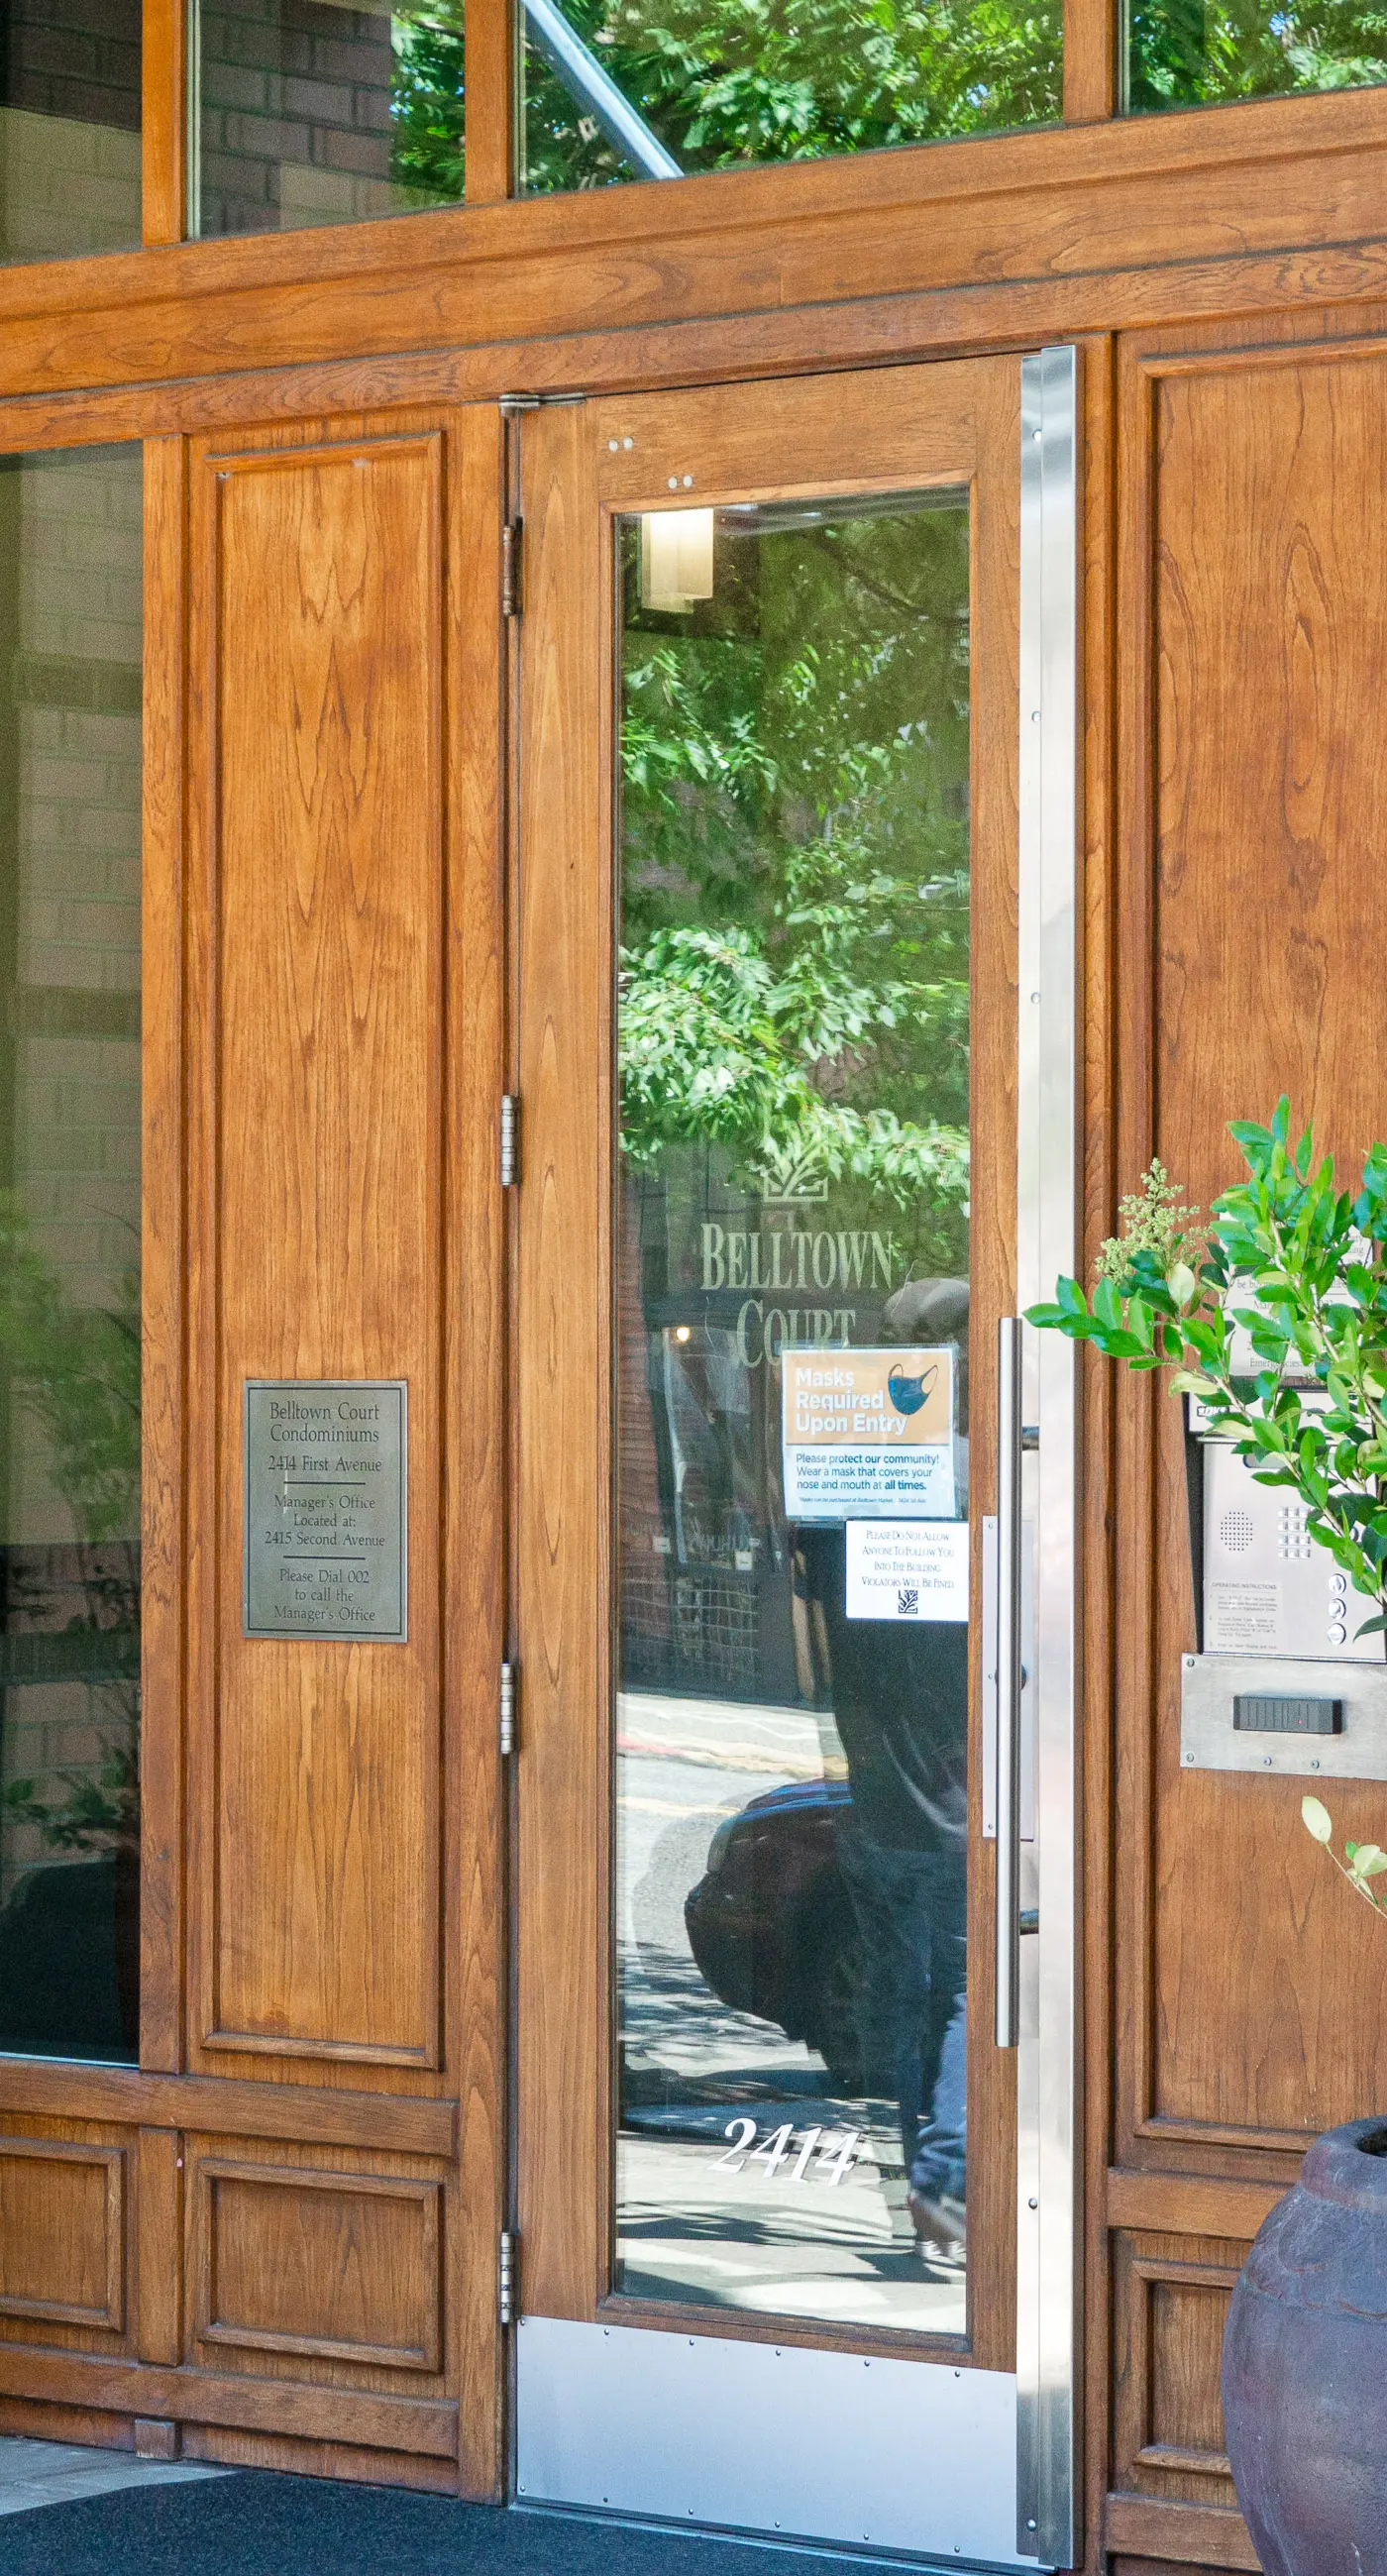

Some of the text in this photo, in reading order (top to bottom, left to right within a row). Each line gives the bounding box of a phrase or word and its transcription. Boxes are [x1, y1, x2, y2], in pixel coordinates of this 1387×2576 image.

[700, 1223, 893, 1290] BELLTOWN
[737, 1299, 856, 1367] COURT
[796, 1367, 855, 1387] Masks
[796, 1390, 884, 1412] Required
[269, 1401, 379, 1421] Belltown Court
[796, 1413, 908, 1436] Upon Entry
[270, 1424, 379, 1443] Condominiums
[267, 1454, 382, 1472] 2414 First Avenue
[797, 1453, 826, 1463] Please
[828, 1453, 862, 1465] protect
[883, 1453, 939, 1465] community!
[797, 1466, 822, 1476] Wear
[831, 1466, 855, 1476] mask
[858, 1466, 876, 1476] that
[879, 1467, 909, 1477] covers
[911, 1468, 933, 1478] your
[821, 1479, 838, 1489] and
[840, 1479, 871, 1489] mouth
[873, 1480, 883, 1489] at
[885, 1480, 896, 1490] all
[898, 1480, 927, 1490] times.
[274, 1494, 375, 1512] Manager's Office
[293, 1513, 357, 1528] Located at:
[265, 1531, 385, 1547] 2415 Second Avenue
[866, 1530, 950, 1541] PLEASE DO NOT ALLOW
[862, 1546, 893, 1556] ANYONE
[895, 1546, 906, 1556] TO
[937, 1547, 955, 1557] YOU
[875, 1561, 891, 1570] INTO
[893, 1561, 906, 1571] THE
[279, 1568, 370, 1584] Please Dial 002
[862, 1576, 902, 1587] VIOLATORS
[903, 1577, 921, 1587] WILL
[295, 1586, 354, 1602] to call the
[274, 1606, 375, 1624] Manager's Office
[707, 2117, 860, 2187] 2414
